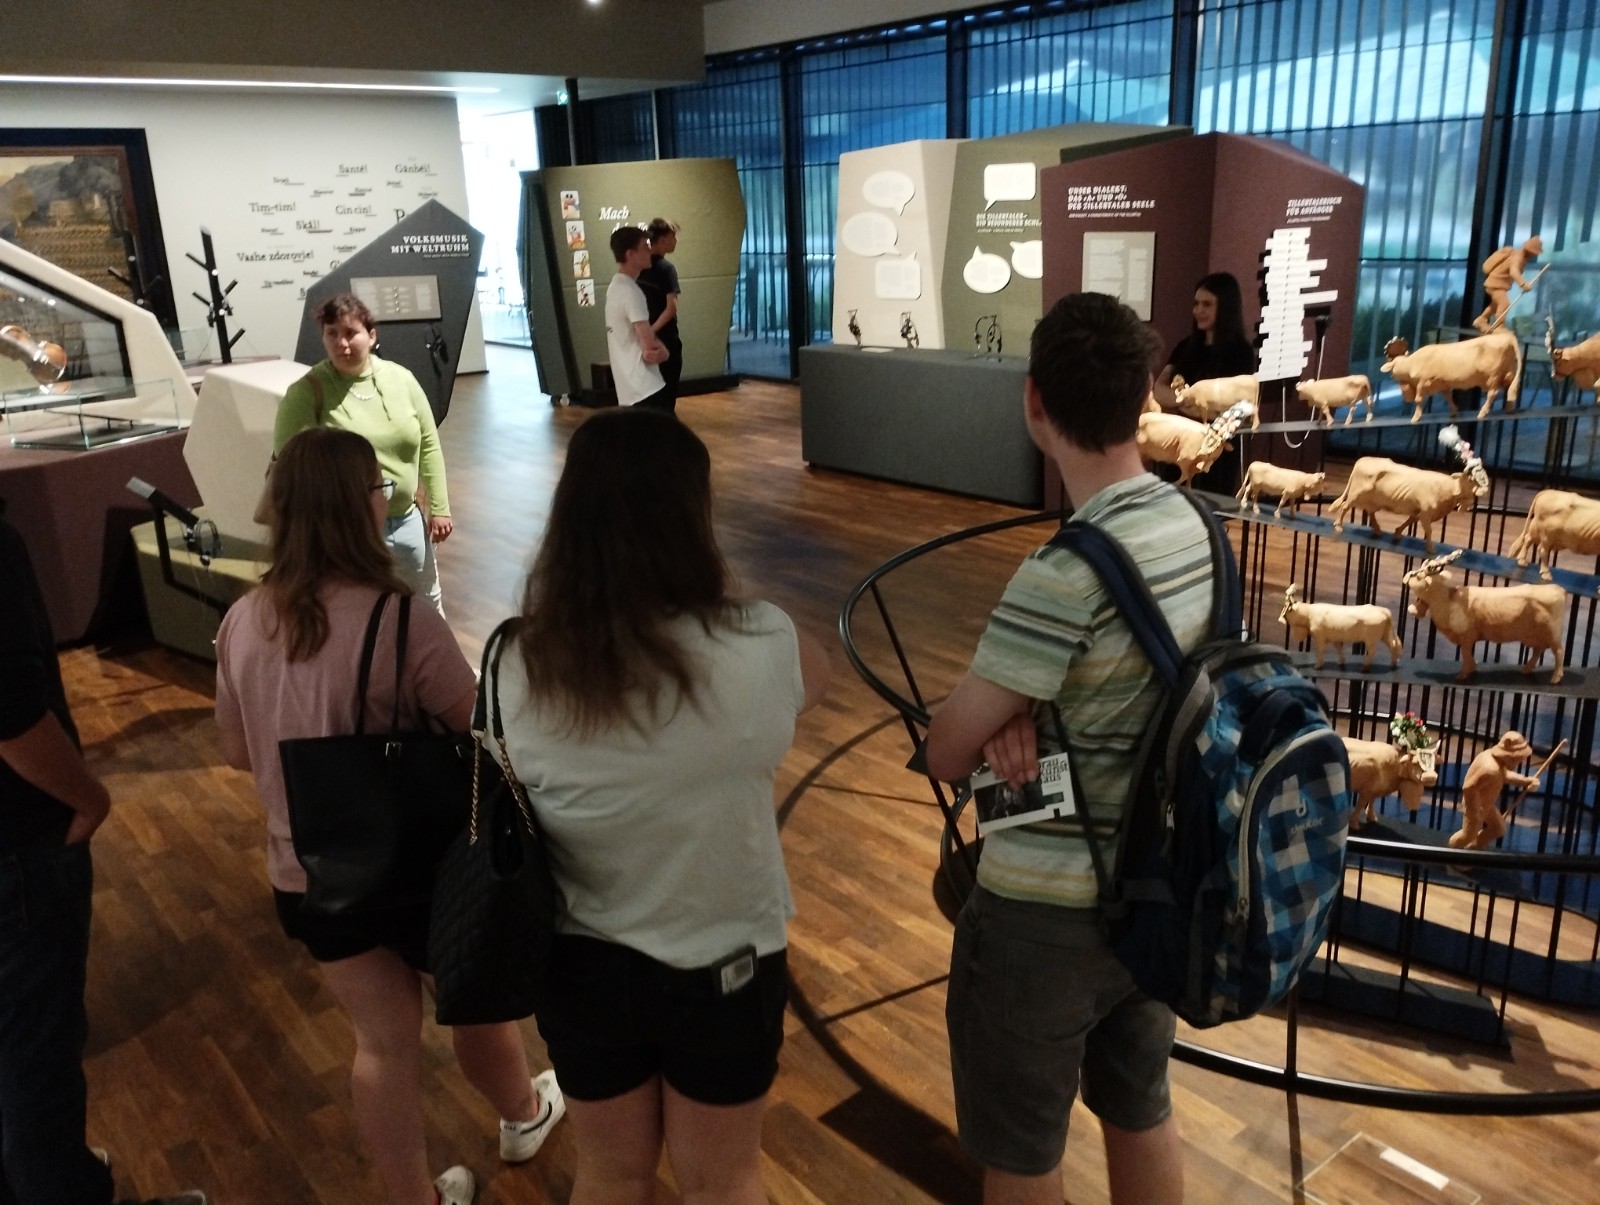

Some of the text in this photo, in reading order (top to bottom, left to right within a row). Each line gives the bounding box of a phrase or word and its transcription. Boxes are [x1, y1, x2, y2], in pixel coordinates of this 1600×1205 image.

[403, 234, 468, 244] VOLKSMUSIK
[391, 243, 470, 254] MIT WELTRUHM
